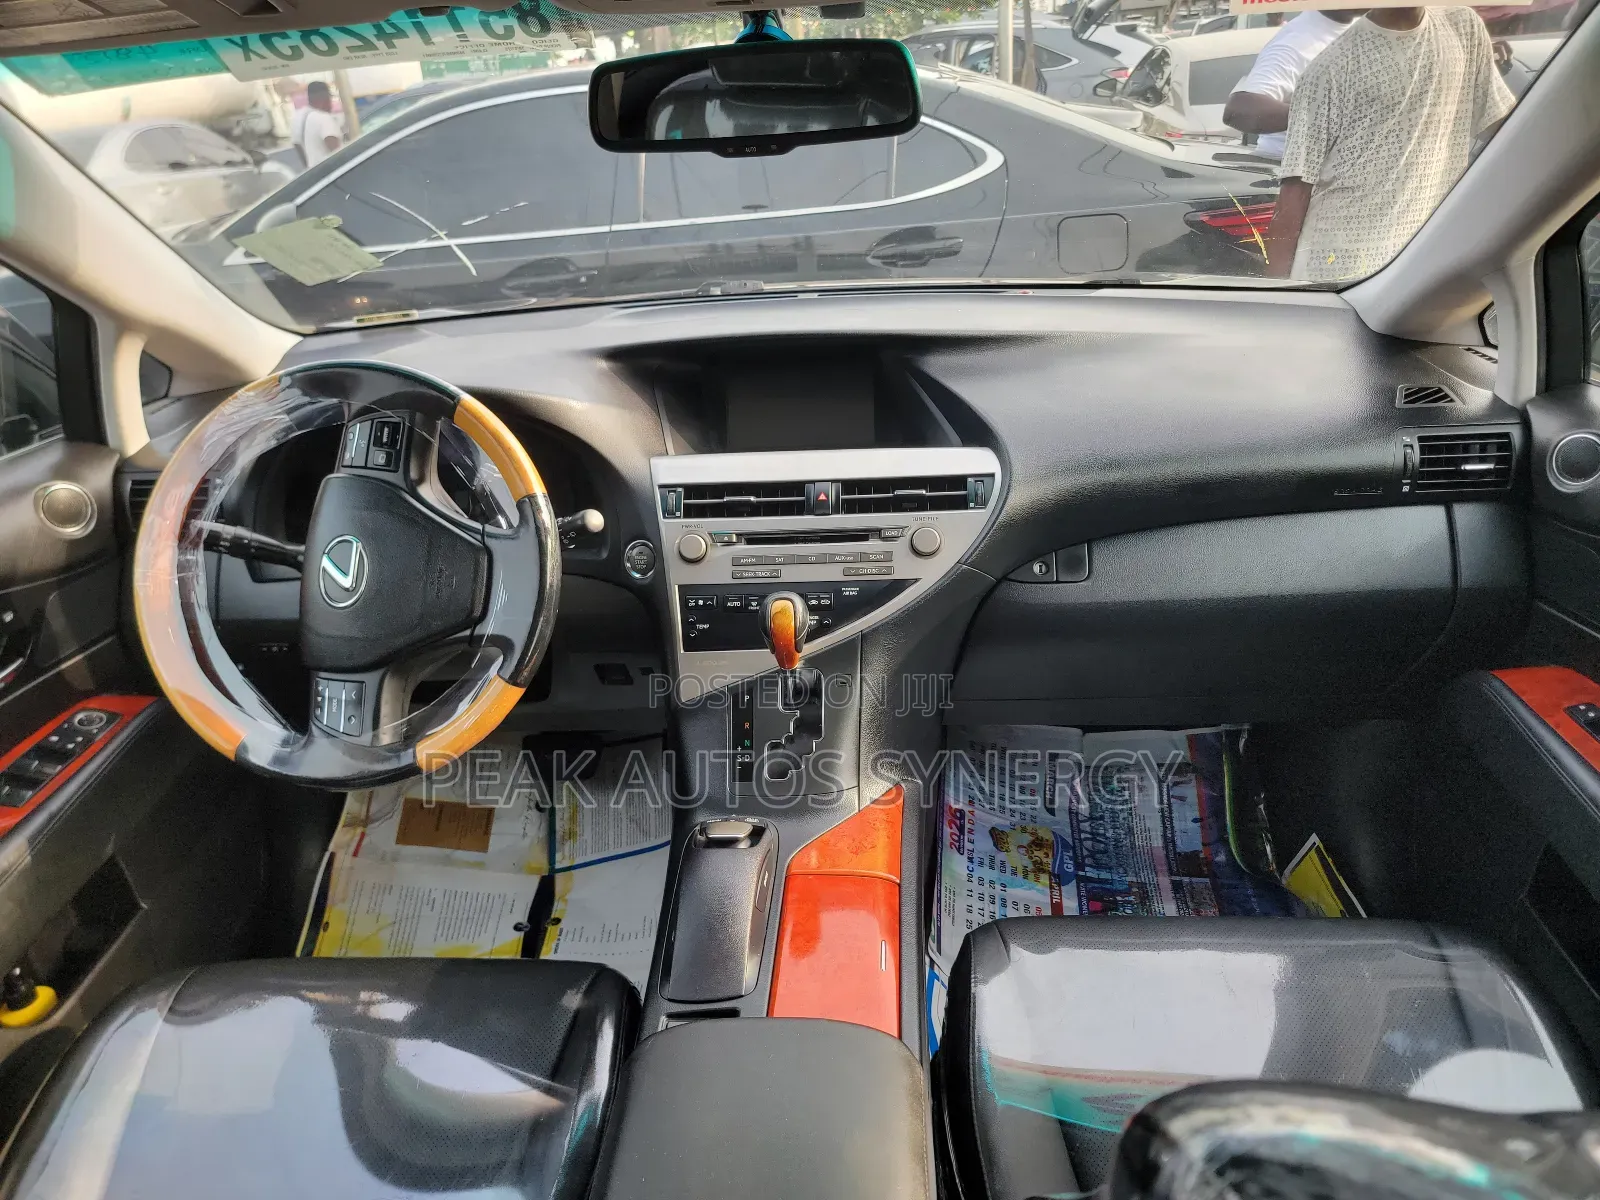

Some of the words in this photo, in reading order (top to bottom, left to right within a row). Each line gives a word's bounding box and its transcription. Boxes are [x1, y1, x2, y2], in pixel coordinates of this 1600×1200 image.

[948, 805, 961, 849] 2026
[1063, 849, 1074, 872] GPL
[967, 873, 973, 883] 04
[978, 877, 984, 886] 03
[989, 880, 995, 889] 02
[1000, 883, 1007, 892] 01
[967, 889, 973, 897] 11
[978, 892, 984, 901] 10
[989, 895, 995, 904] 09
[1001, 898, 1007, 908] 08
[966, 904, 973, 913] 18
[1012, 901, 1018, 911] 07
[1024, 904, 1030, 914] 06
[1080, 896, 1088, 915] WOME
[978, 908, 984, 917] 17
[966, 919, 972, 930] 25
